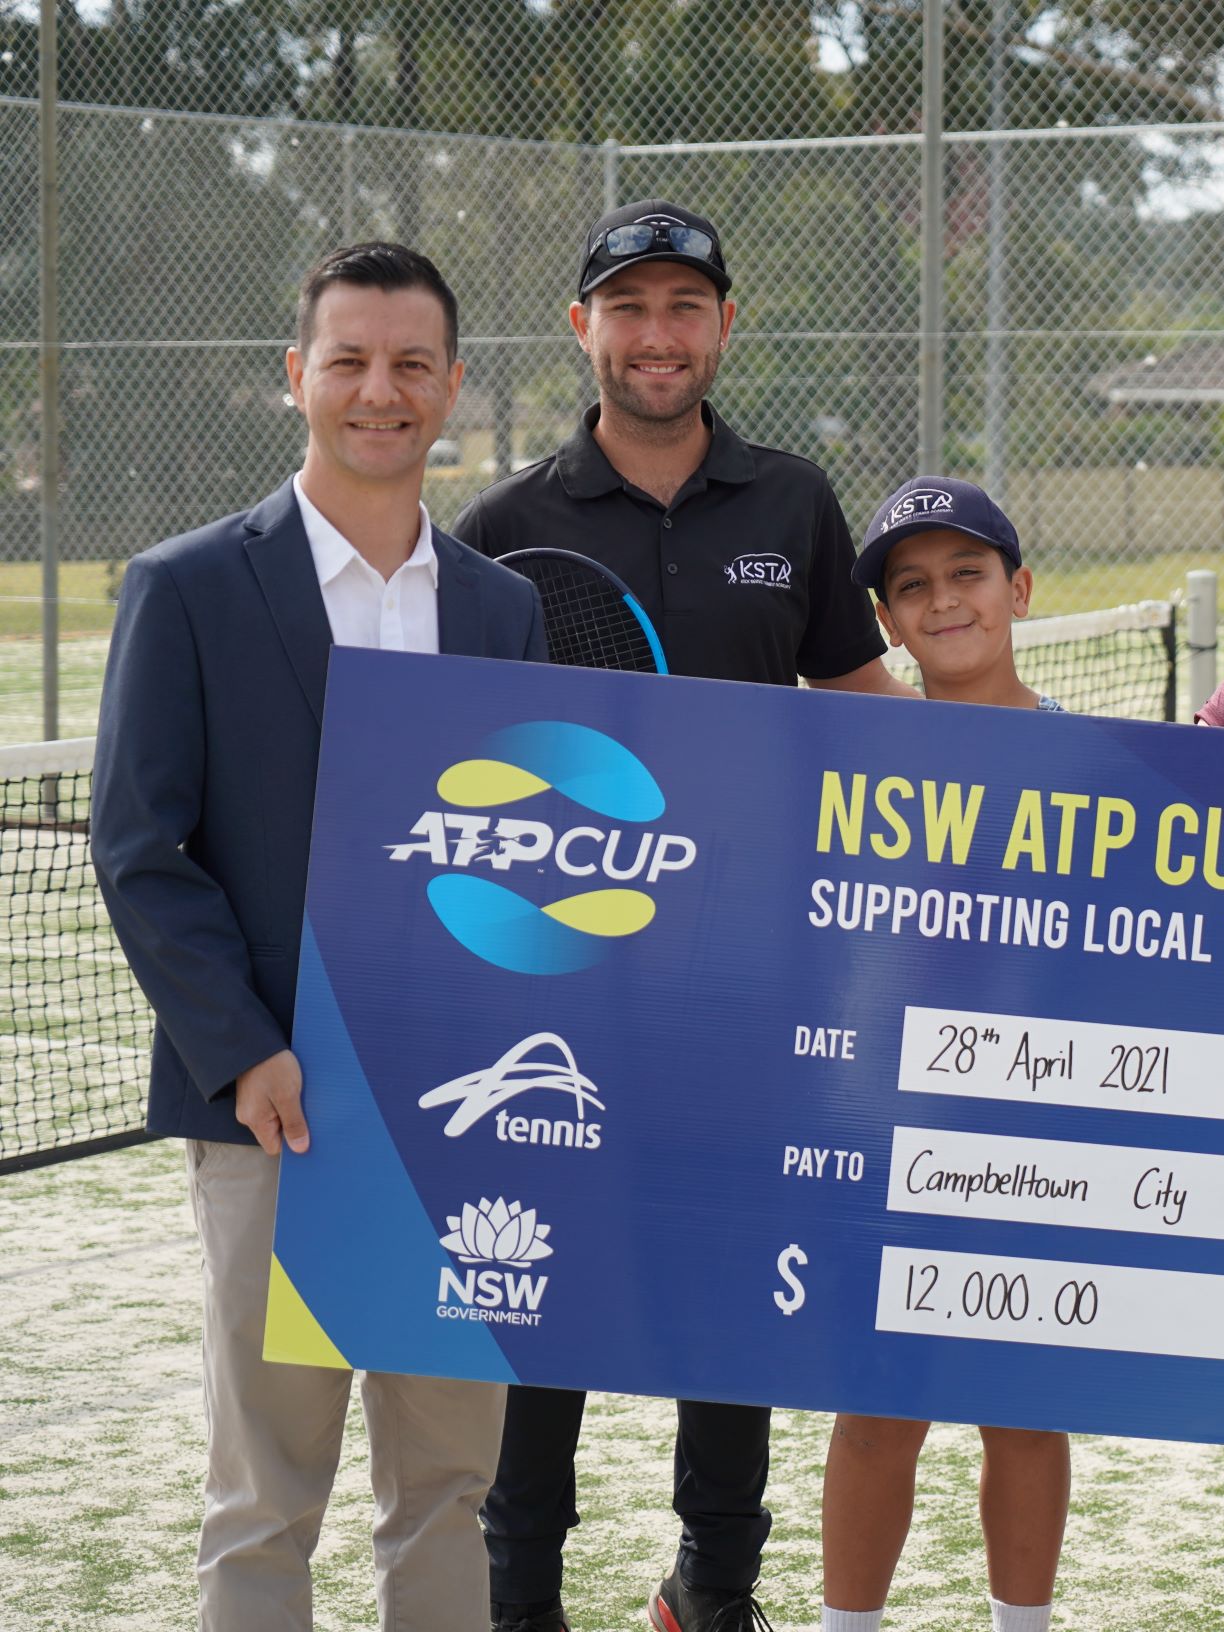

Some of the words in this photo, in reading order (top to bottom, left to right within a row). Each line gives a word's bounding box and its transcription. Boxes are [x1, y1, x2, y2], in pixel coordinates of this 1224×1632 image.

[891, 495, 952, 524] KSTA
[739, 560, 790, 583] KSTA
[381, 811, 554, 870] ATP
[555, 826, 697, 882] CUP
[816, 770, 985, 866] NSW
[1002, 789, 1136, 878] ATP
[808, 878, 1069, 950] SUPPORTING
[1084, 904, 1212, 963] LOCAL
[794, 1026, 857, 1060] DATE
[927, 1025, 1000, 1074] 28th
[1007, 1031, 1074, 1092] April
[1099, 1044, 1170, 1094] 2021
[496, 1109, 602, 1149] tennis
[783, 1146, 831, 1178] PAY
[834, 1151, 864, 1181] TO
[906, 1149, 1088, 1202] Campbelltown
[1133, 1167, 1187, 1225] City
[438, 1267, 548, 1310] NSW
[773, 1244, 808, 1315] $
[906, 1264, 1098, 1326] 12,000.00
[436, 1305, 542, 1326] GOVERNMENT
